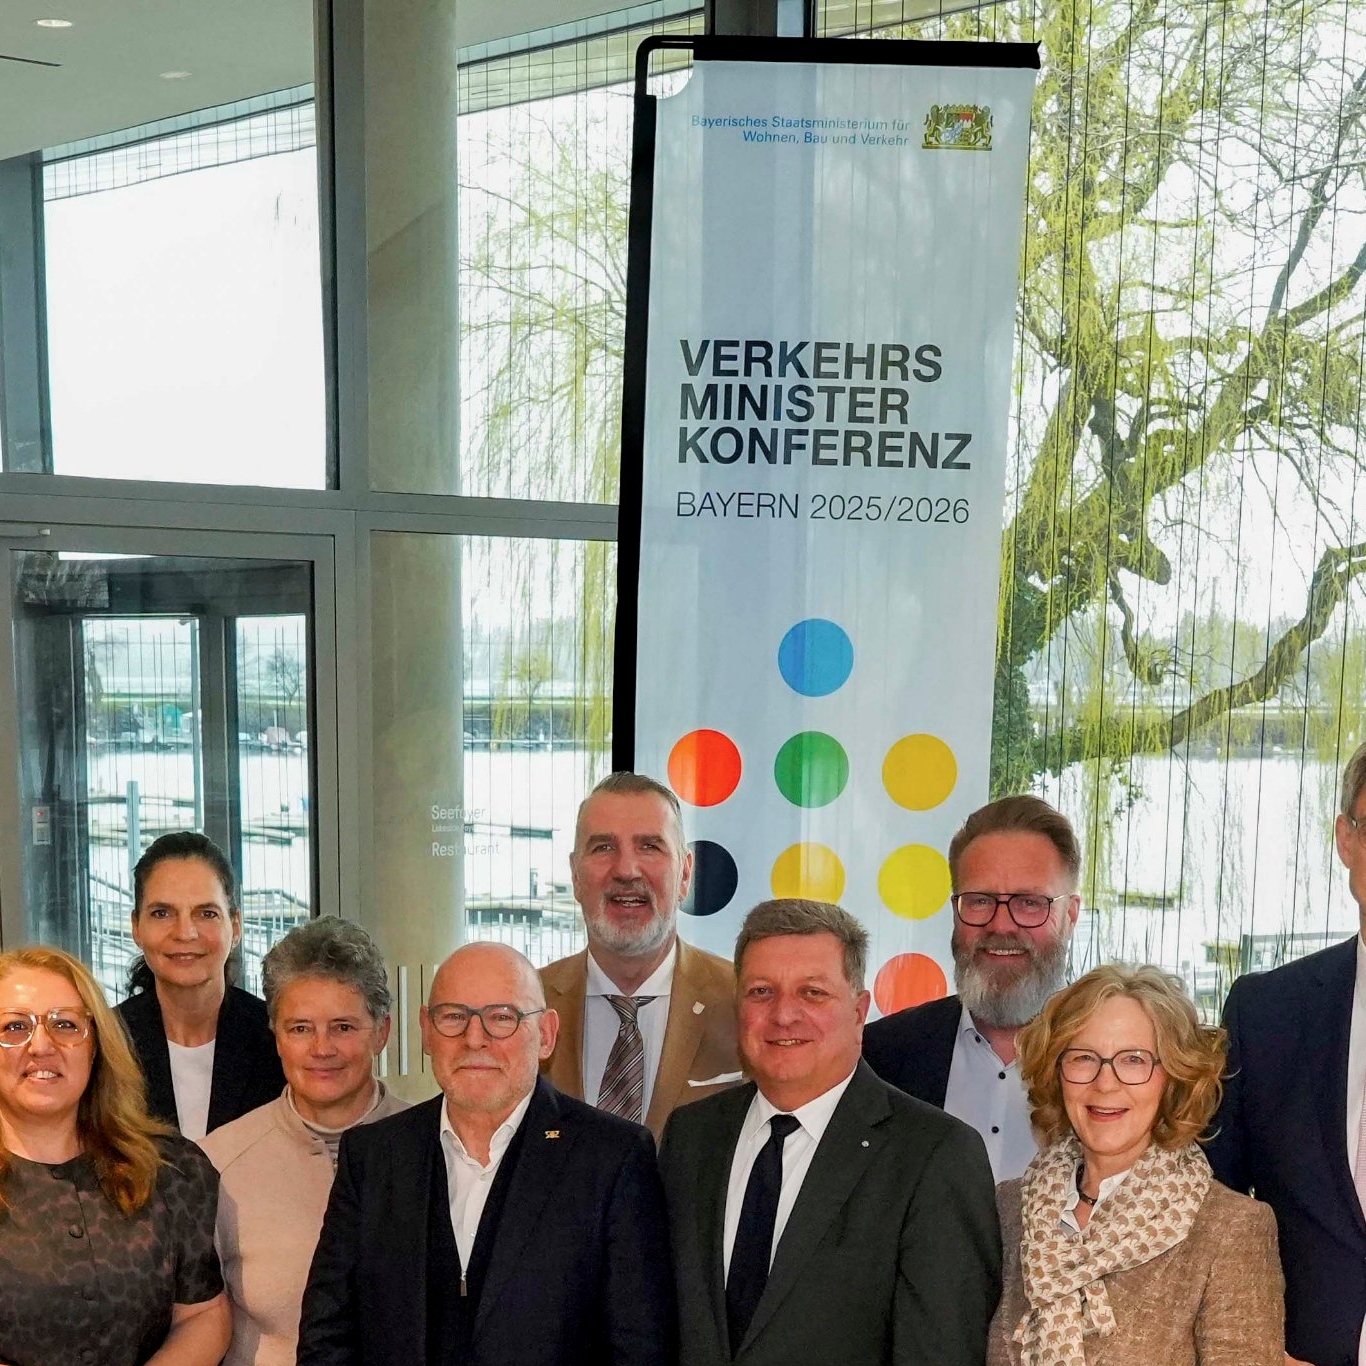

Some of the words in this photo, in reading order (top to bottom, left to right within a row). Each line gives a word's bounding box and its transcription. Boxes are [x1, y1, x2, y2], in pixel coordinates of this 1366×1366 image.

[691, 115, 768, 129] Bayerisches
[771, 116, 888, 130] Staatsministerium
[892, 118, 910, 131] für
[742, 130, 800, 144] Wohnen,
[804, 131, 828, 144] Bau
[832, 133, 856, 145] und
[860, 133, 909, 146] Verkehr
[679, 339, 943, 383] VERKEHRS
[679, 383, 910, 425] MINISTER
[678, 426, 973, 470] KONFERENZ
[676, 492, 799, 519] BAYERN
[810, 494, 970, 524] 2025/2026
[431, 804, 486, 822] Seefoyer
[431, 842, 499, 857] Restaurant
